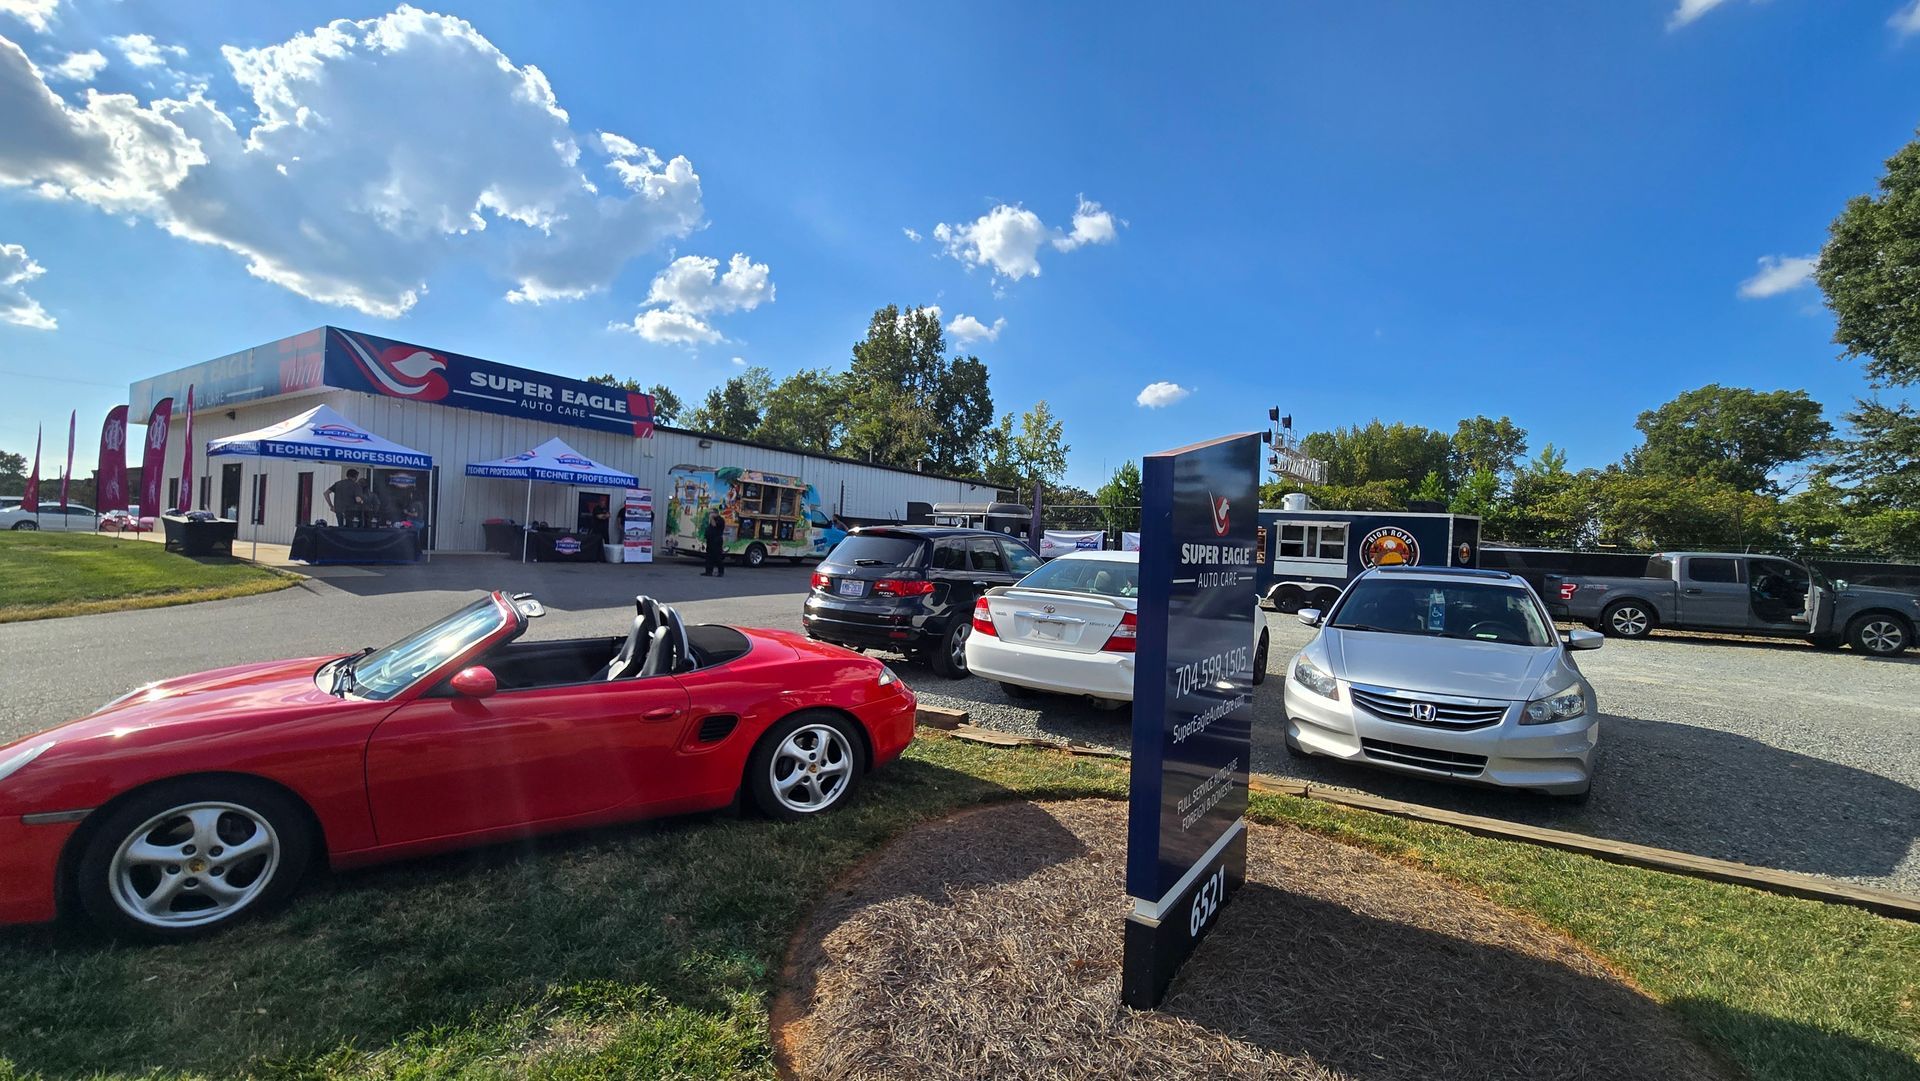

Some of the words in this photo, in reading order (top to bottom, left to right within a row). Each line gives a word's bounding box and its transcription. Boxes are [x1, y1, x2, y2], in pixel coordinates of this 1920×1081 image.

[470, 371, 553, 400] SUPER
[561, 389, 627, 414] EAGLE
[520, 399, 553, 412] AUTO
[557, 405, 587, 418] CARE
[266, 442, 331, 458] TECHNET
[335, 449, 428, 467] PROFESSIONAL
[467, 466, 489, 475] TECHNET
[489, 467, 528, 477] PROFESSIONAL
[535, 469, 575, 480] TECHNET
[577, 473, 636, 486] PROFESSIONAL
[1368, 529, 1388, 544] HIGH
[1390, 529, 1412, 545] ROAD
[1181, 543, 1219, 564] SUPER
[1221, 546, 1250, 565] EAGLE
[1197, 572, 1218, 588] AUTO
[1220, 571, 1238, 587] CARE
[1175, 646, 1247, 699] 704.599.1505
[1177, 793, 1192, 815] FULL
[1192, 775, 1214, 804] SERVICE
[1182, 799, 1206, 833] FOREIGN
[1211, 777, 1234, 807] DOMESTIC
[1190, 864, 1225, 937] 6521
